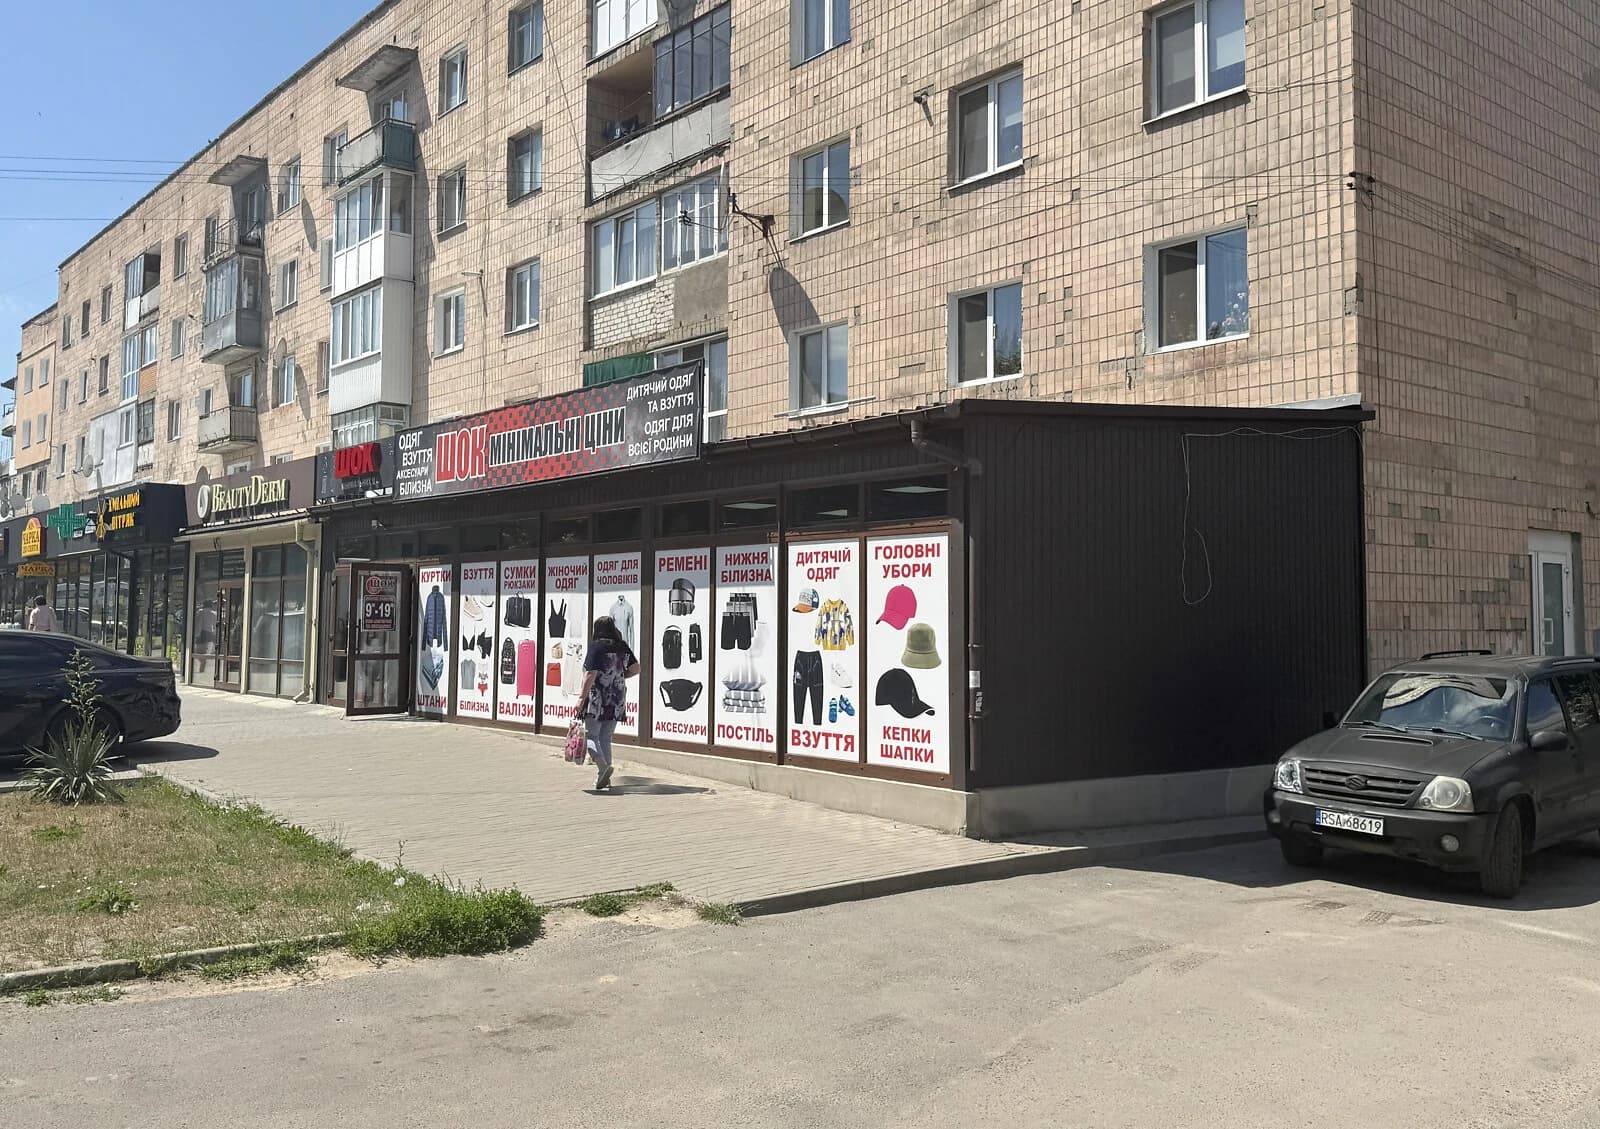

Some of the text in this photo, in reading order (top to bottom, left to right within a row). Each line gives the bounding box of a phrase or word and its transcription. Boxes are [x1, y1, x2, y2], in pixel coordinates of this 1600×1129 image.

[627, 373, 694, 402] ДИТЯЧИЙ ОДЯГ
[647, 392, 694, 413] ТА ВЗУТТЯ
[644, 413, 693, 436] ОДЯГ ДЛЯ
[398, 431, 423, 450] ОДЯГ
[435, 406, 627, 484] ШОК МІНІМАЛЬНІ ЦІНИ
[628, 433, 693, 456] ВСІЄЇ РОДИНИ
[334, 441, 376, 480] ШОК
[402, 448, 433, 466] ВЗУТТЯ
[396, 465, 429, 480] АКСЕСУАРИ
[399, 480, 432, 496] БІЛИЗНА
[724, 551, 768, 566] НИЖНЯ
[796, 547, 851, 567] ДИТЯЧІЙ
[874, 543, 941, 560] ГОЛОВНІ
[548, 563, 588, 577] ЖІНОЧИЙ
[597, 559, 639, 573] ОДЯГ ДЛЯ
[658, 555, 707, 572] РЕМЕНІ
[882, 563, 932, 579] УБОРИ
[421, 570, 452, 583] КУРТКИ
[463, 567, 494, 580] ВЗУТТЯ
[503, 565, 536, 579] СУМКИ
[597, 574, 638, 585] ЧОЛОВІКІВ
[721, 568, 772, 583] БІЛИЗНА
[806, 567, 840, 582] ОДЯГ
[503, 580, 536, 590] РЮКЗАКИ
[555, 577, 579, 591] ОДЯГ
[417, 694, 447, 708] ШТАНИ
[459, 700, 490, 713] БІЛИЗНА
[498, 702, 534, 717] ВАЛІЗИ
[655, 721, 707, 736] АКСЕСУАРИ
[717, 724, 774, 743] ПОСТІЛЬ
[882, 726, 931, 744] КЕПКИ
[791, 729, 855, 752] ВЗУТТЯ
[880, 743, 934, 764] ШАПКИ
[1321, 812, 1342, 827] RSA
[1346, 816, 1382, 832] 68619
